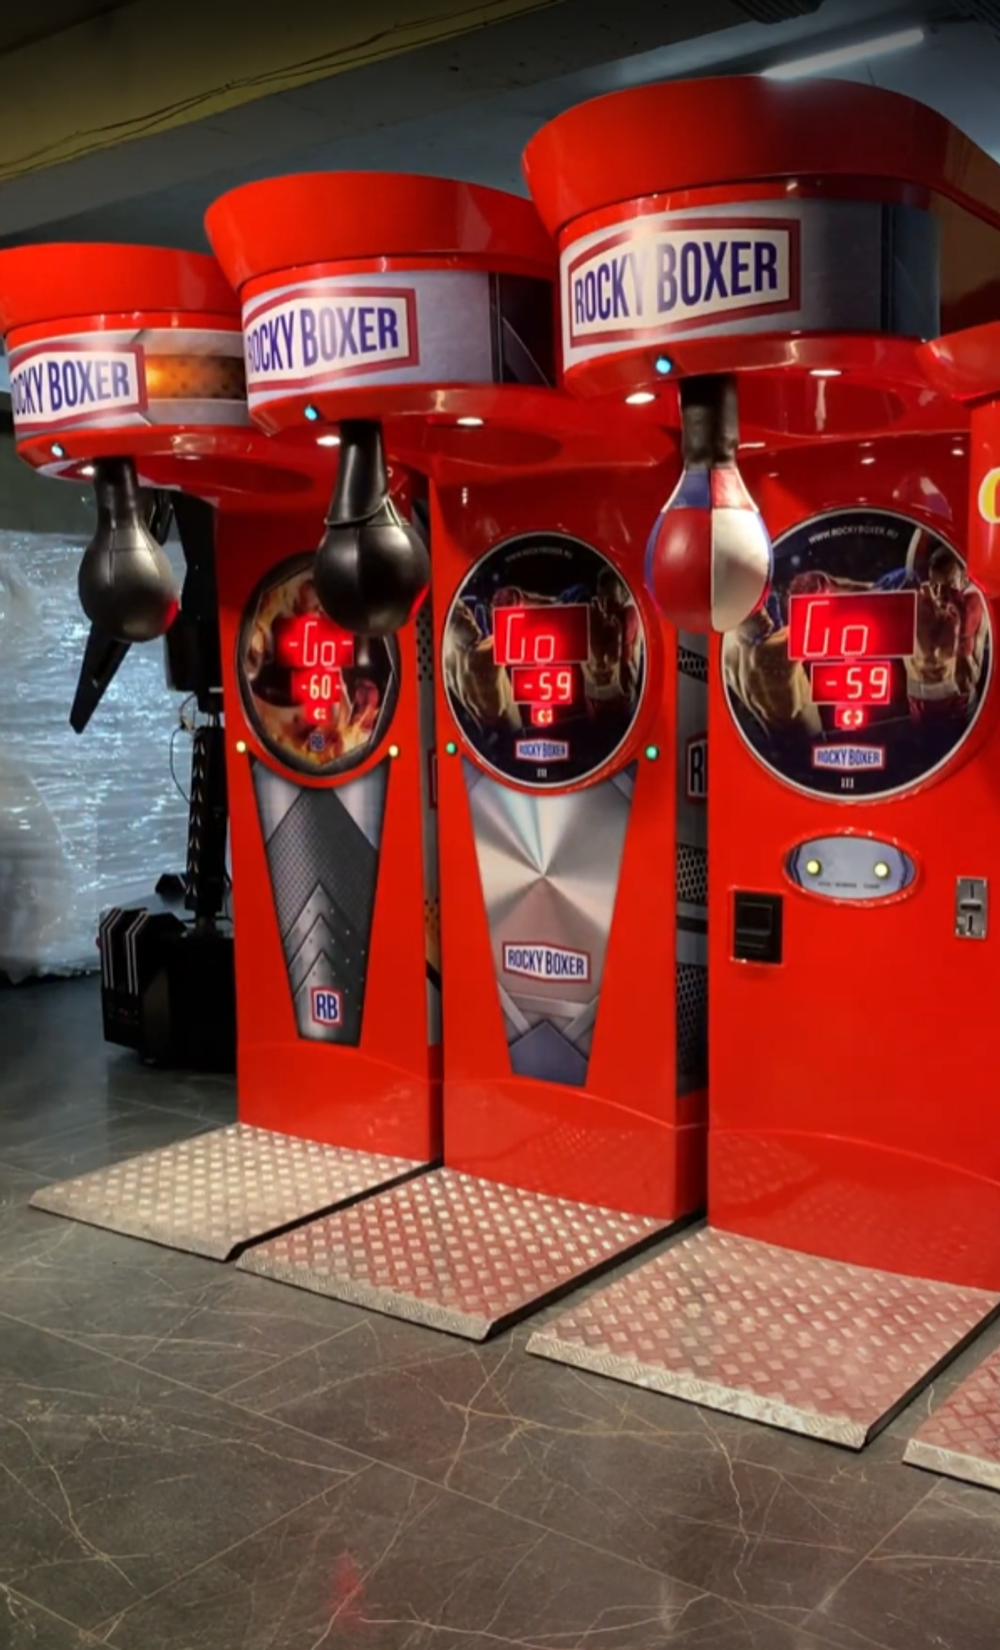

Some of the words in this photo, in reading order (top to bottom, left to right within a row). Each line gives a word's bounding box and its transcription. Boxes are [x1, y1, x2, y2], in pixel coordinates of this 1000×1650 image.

[573, 250, 648, 326] ROCKY
[657, 240, 778, 314] BOXER
[300, 305, 400, 368] BOXER
[47, 359, 130, 412] BOXER
[803, 600, 868, 657] Go
[817, 748, 847, 766] ROCKY
[849, 748, 880, 766] BOXER
[508, 949, 544, 974] ROCKY
[545, 950, 585, 976] BOXER
[315, 992, 339, 1021] RB
